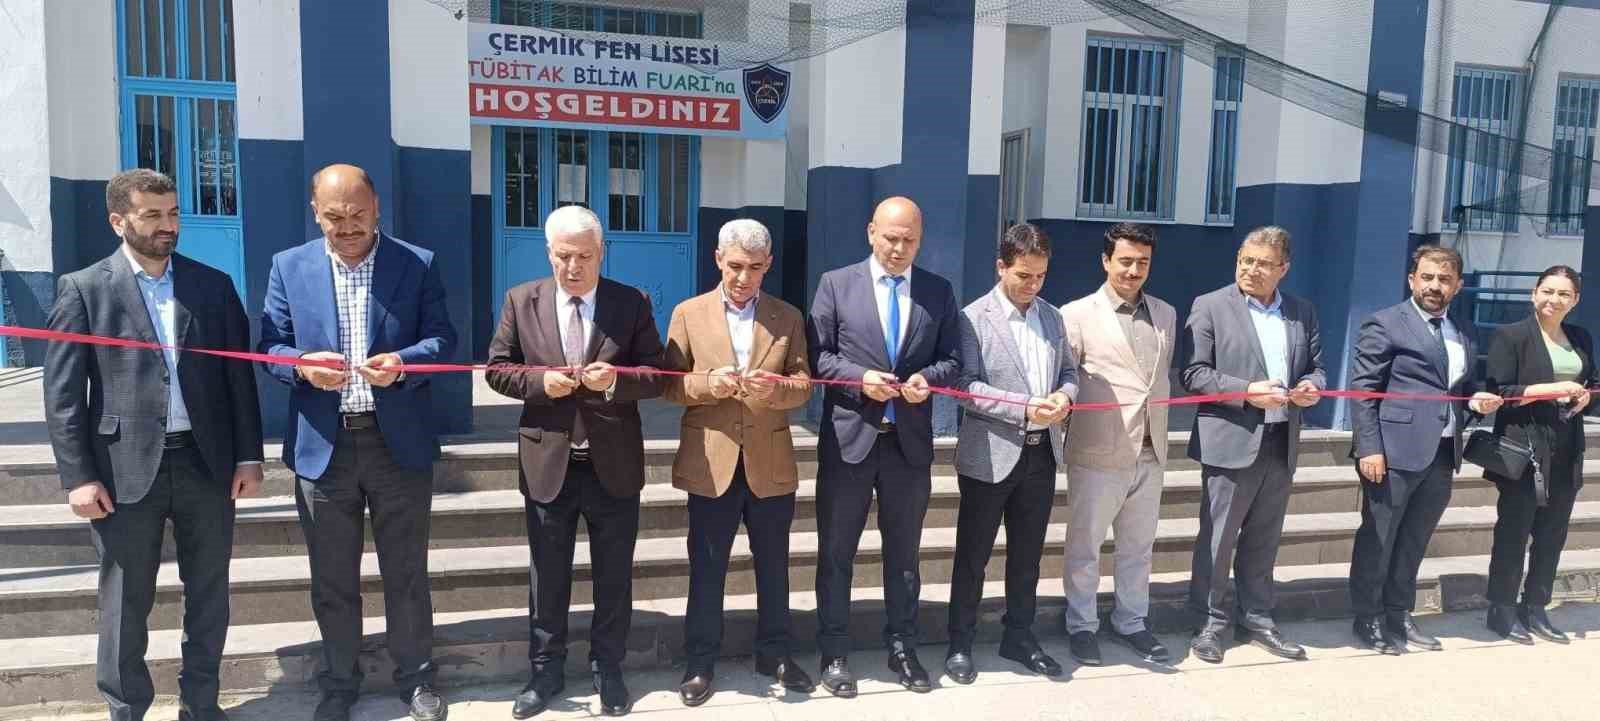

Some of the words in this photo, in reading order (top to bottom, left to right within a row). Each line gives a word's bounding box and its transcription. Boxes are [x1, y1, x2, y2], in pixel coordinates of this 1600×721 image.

[594, 39, 641, 60] FEN
[468, 57, 565, 83] TÜBİTAK
[574, 65, 638, 88] BİLİM
